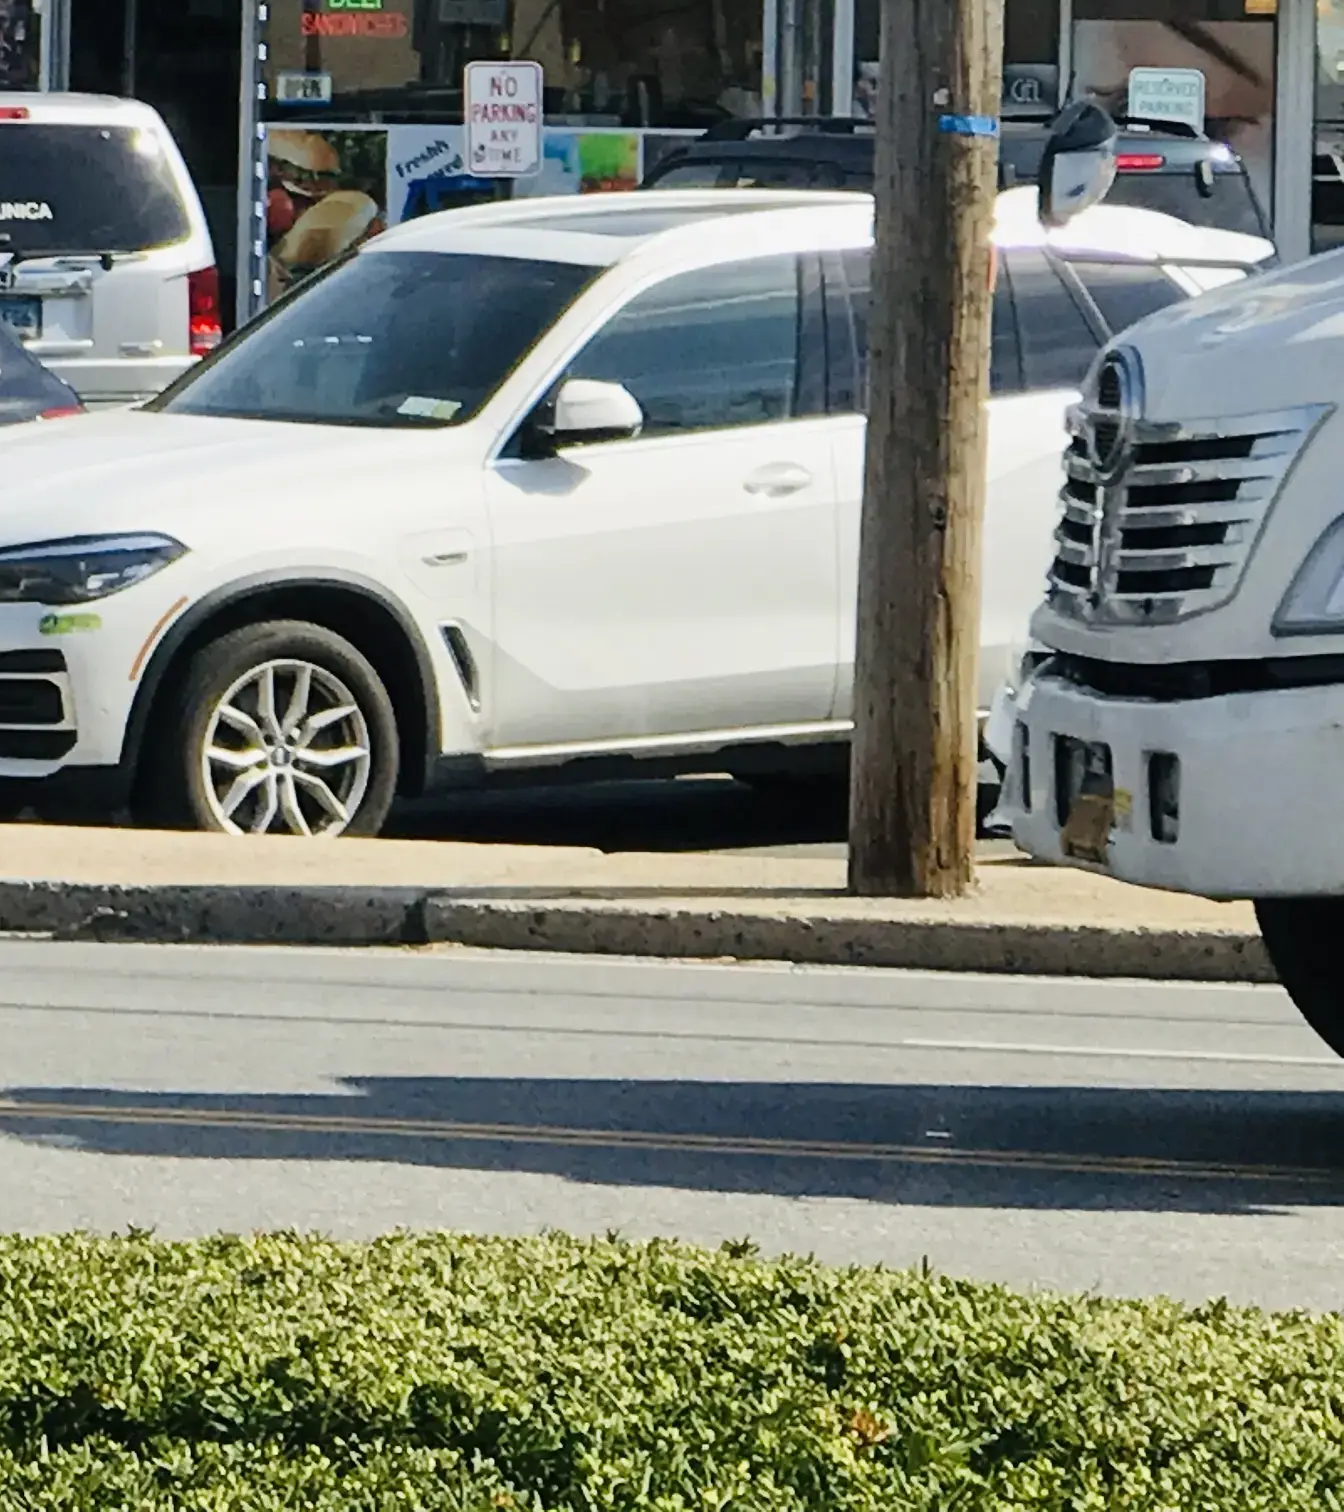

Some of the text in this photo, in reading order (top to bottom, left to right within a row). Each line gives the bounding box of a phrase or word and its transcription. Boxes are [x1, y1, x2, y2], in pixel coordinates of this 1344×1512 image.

[490, 76, 519, 99] NO
[471, 102, 538, 124] PARKING
[490, 128, 518, 143] ANY
